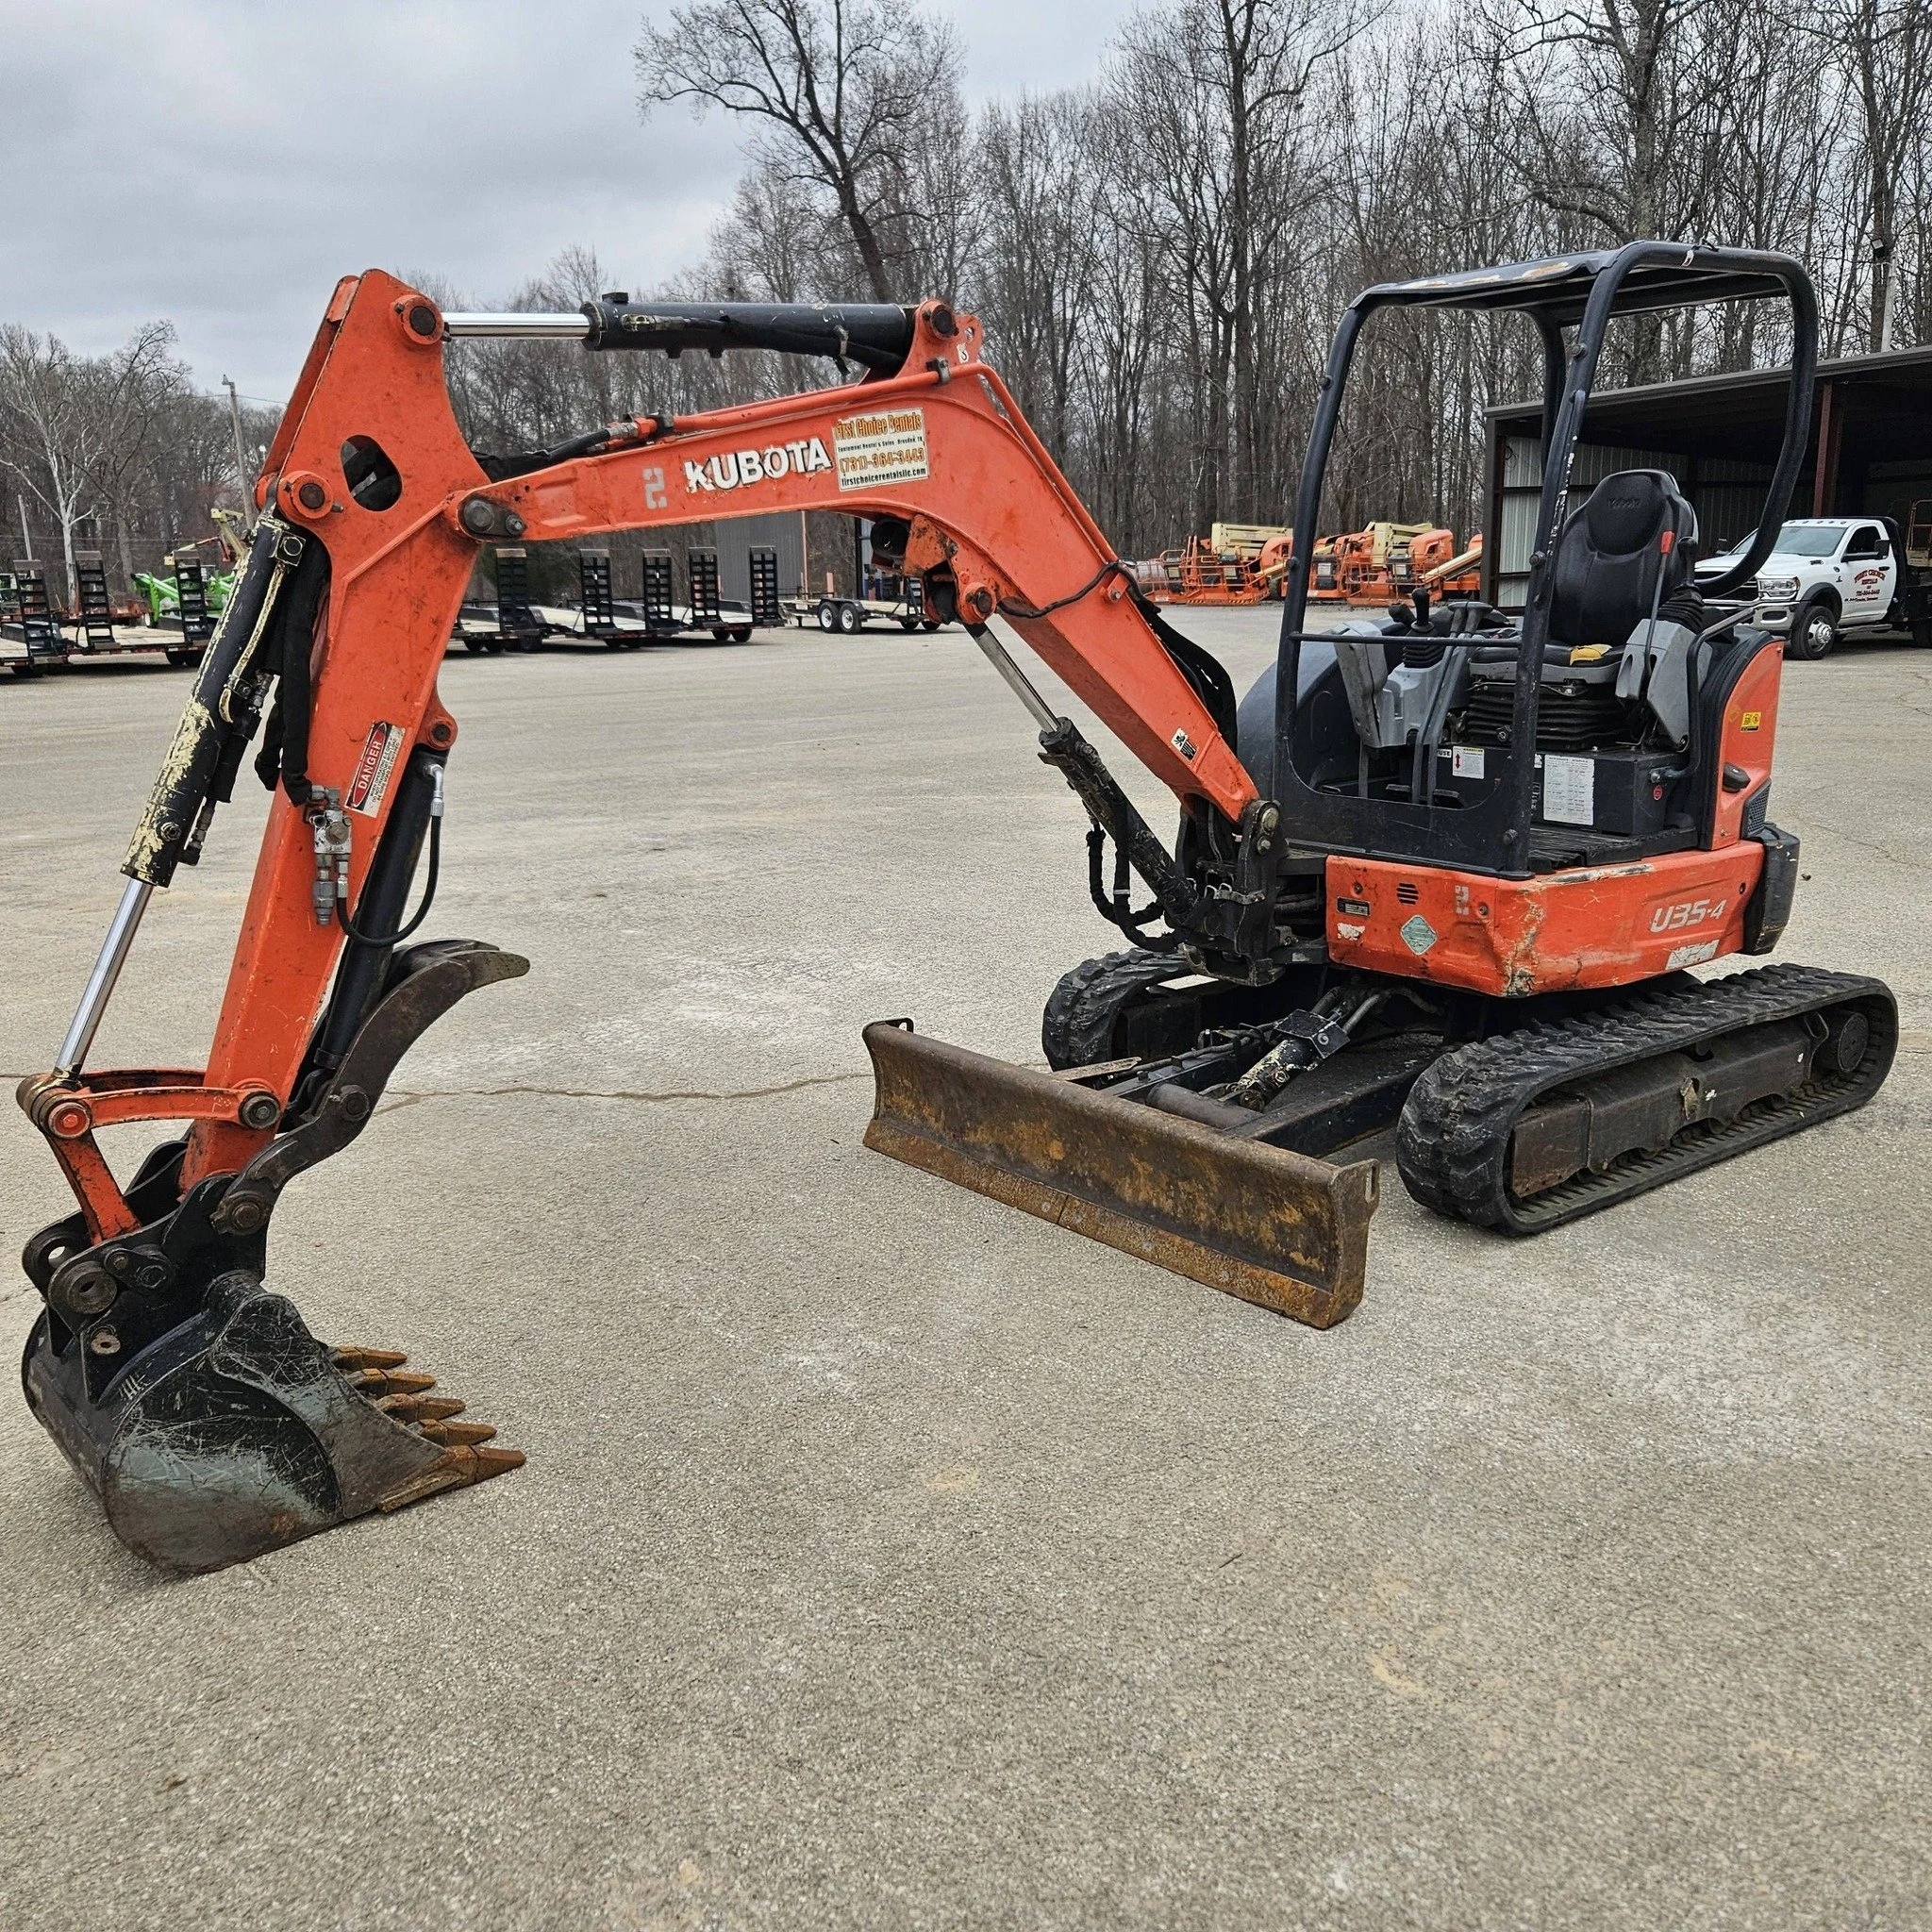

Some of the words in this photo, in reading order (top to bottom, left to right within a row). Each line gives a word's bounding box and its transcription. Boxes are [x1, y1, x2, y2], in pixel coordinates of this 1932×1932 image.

[857, 417, 888, 438] Choice
[888, 412, 921, 434] Rentals
[684, 437, 832, 492] KUBOTA
[841, 468, 925, 487] firstchoicerentalsllc.com
[358, 741, 382, 790] DANGER
[1650, 899, 1726, 933] U35-4
